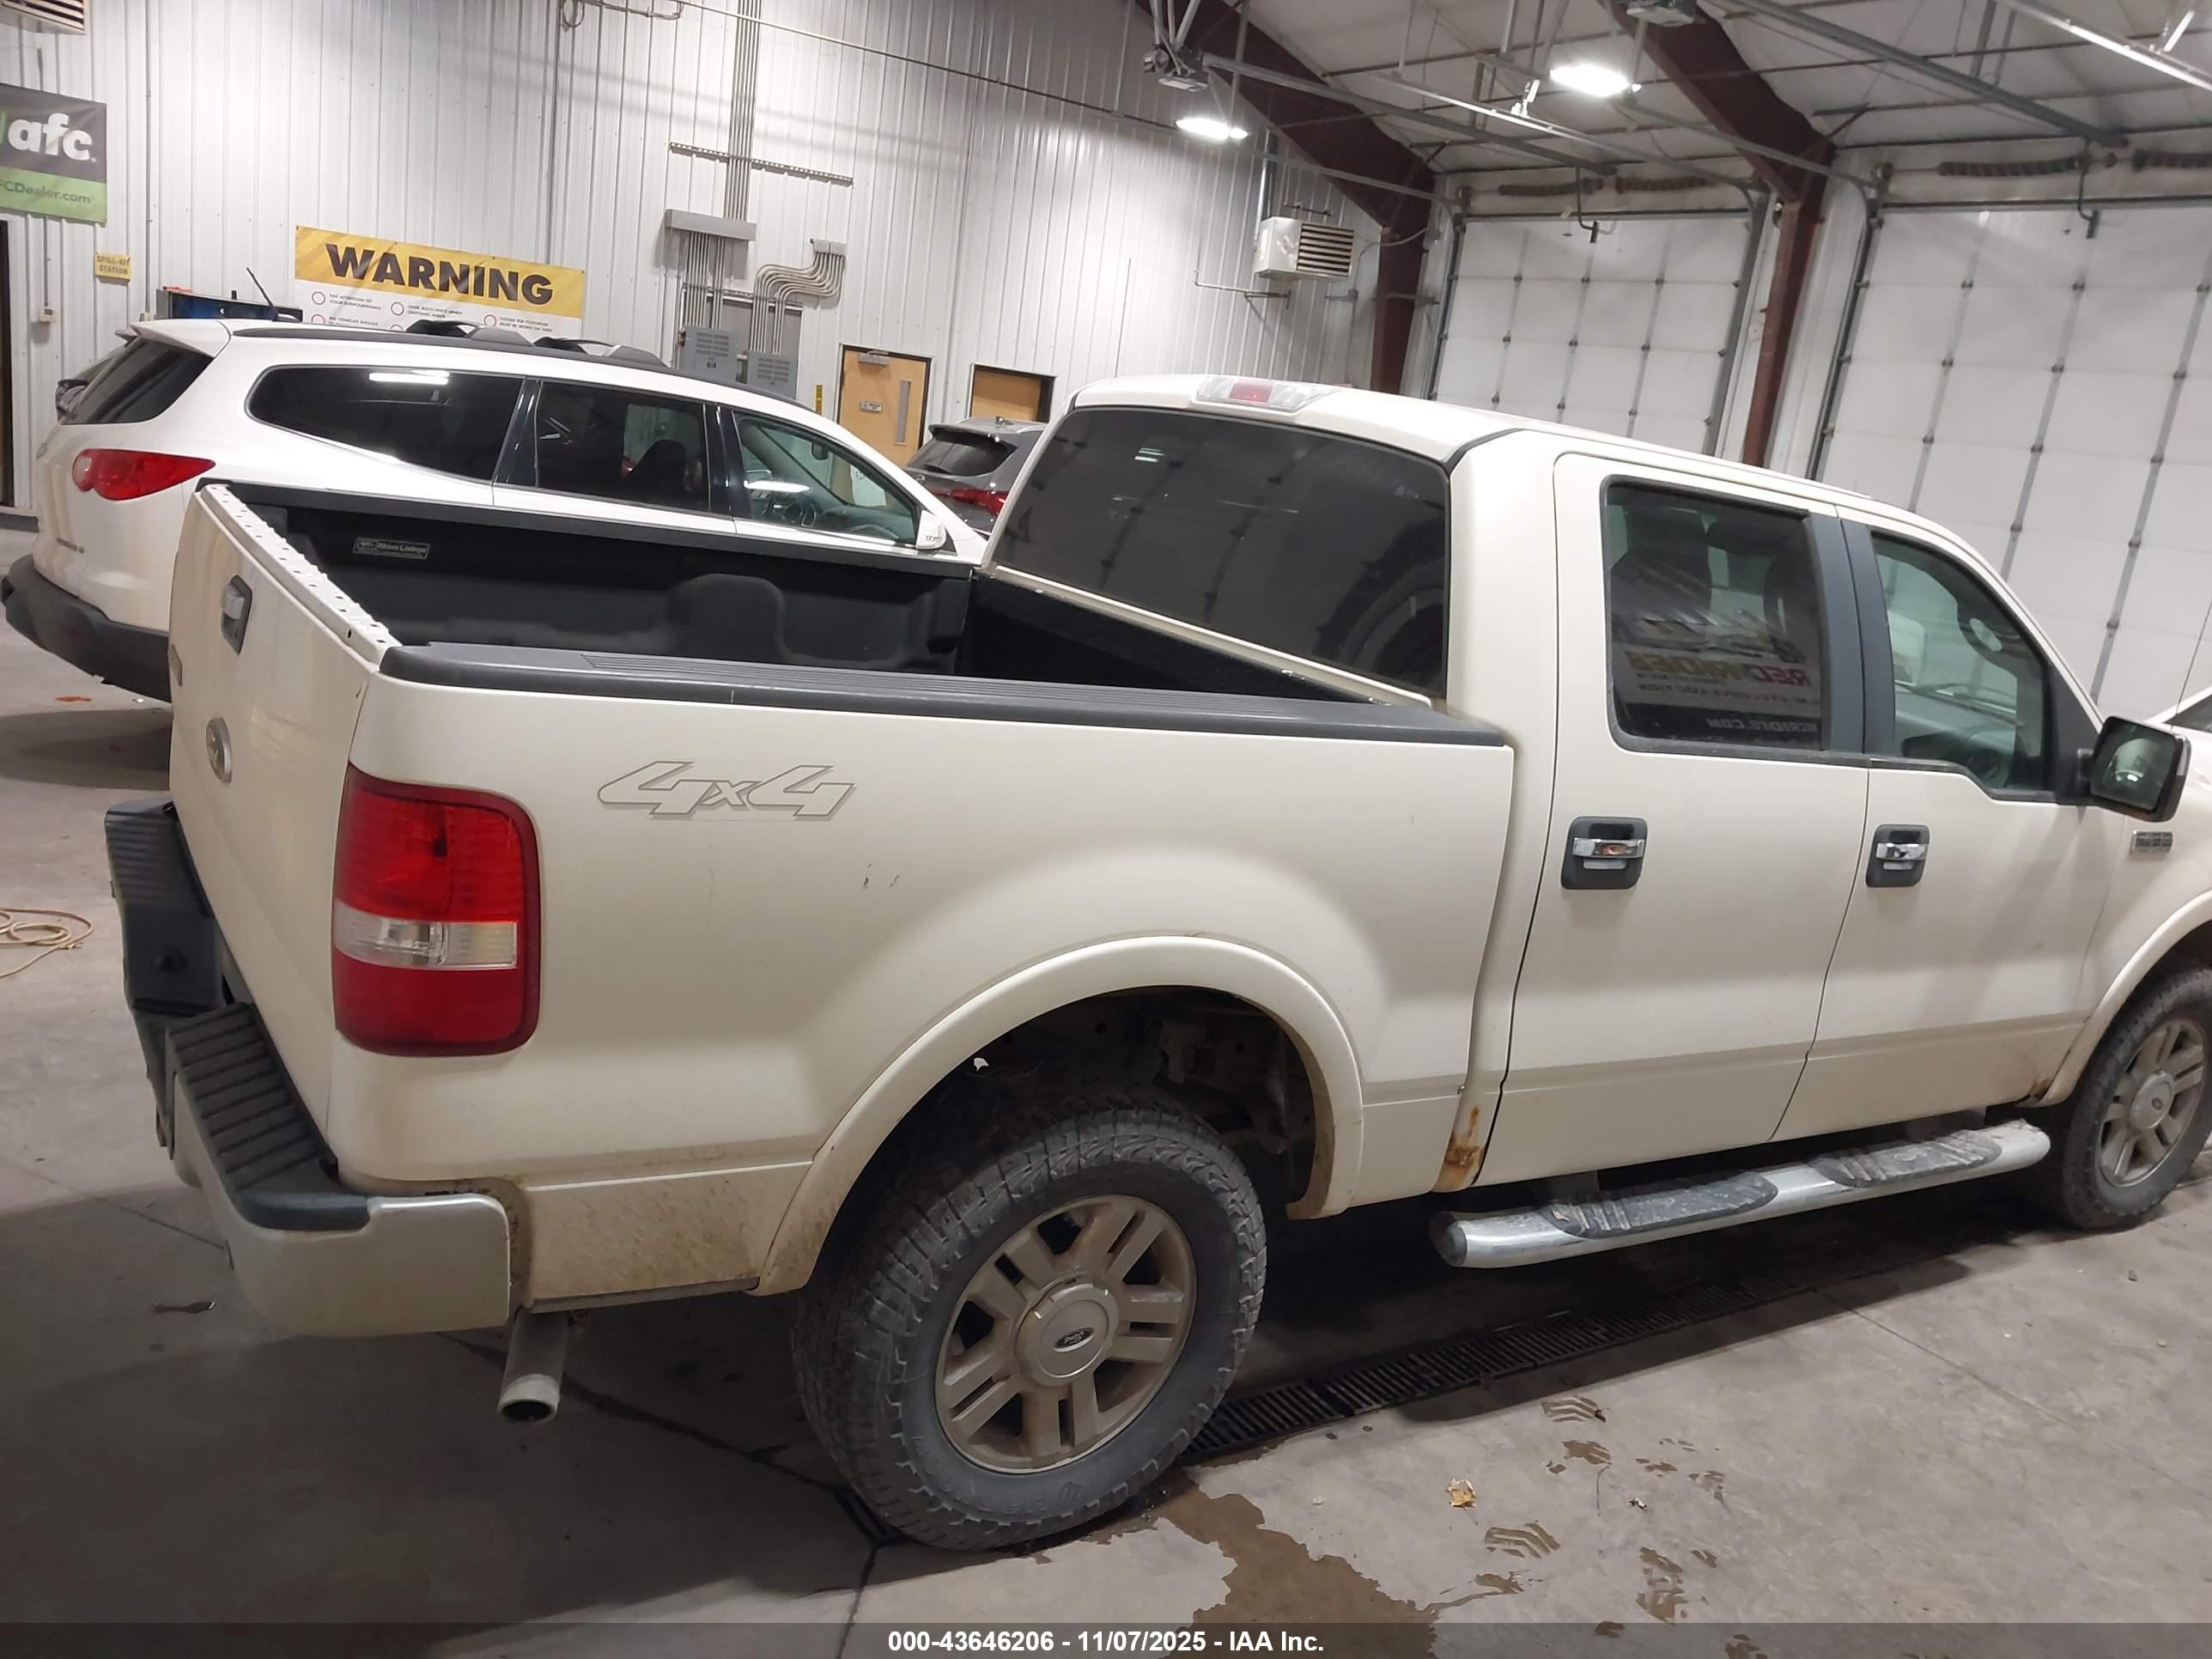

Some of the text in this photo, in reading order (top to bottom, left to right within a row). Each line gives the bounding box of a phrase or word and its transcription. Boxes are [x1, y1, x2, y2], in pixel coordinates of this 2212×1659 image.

[99, 264, 128, 275] STATION
[325, 243, 554, 305] WARNING
[598, 761, 855, 817] 4x4
